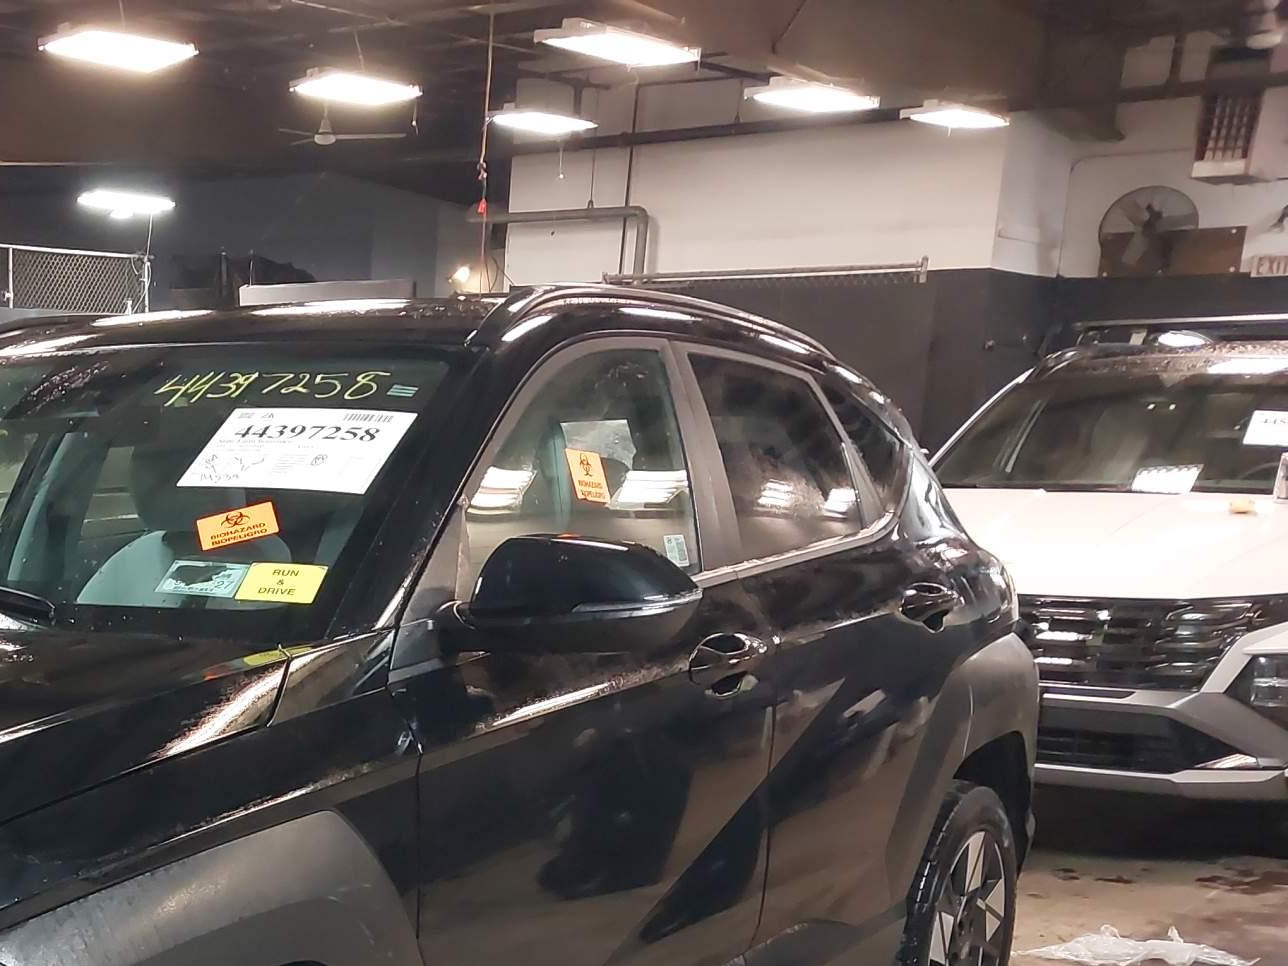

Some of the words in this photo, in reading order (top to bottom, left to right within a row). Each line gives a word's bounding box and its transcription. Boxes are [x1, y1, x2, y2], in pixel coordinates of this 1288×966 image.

[154, 370, 391, 407] 44397258
[234, 424, 380, 442] 44397258
[210, 522, 266, 540] BIOHAZARD
[272, 569, 300, 577] RUN
[257, 587, 296, 596] DRIVE
